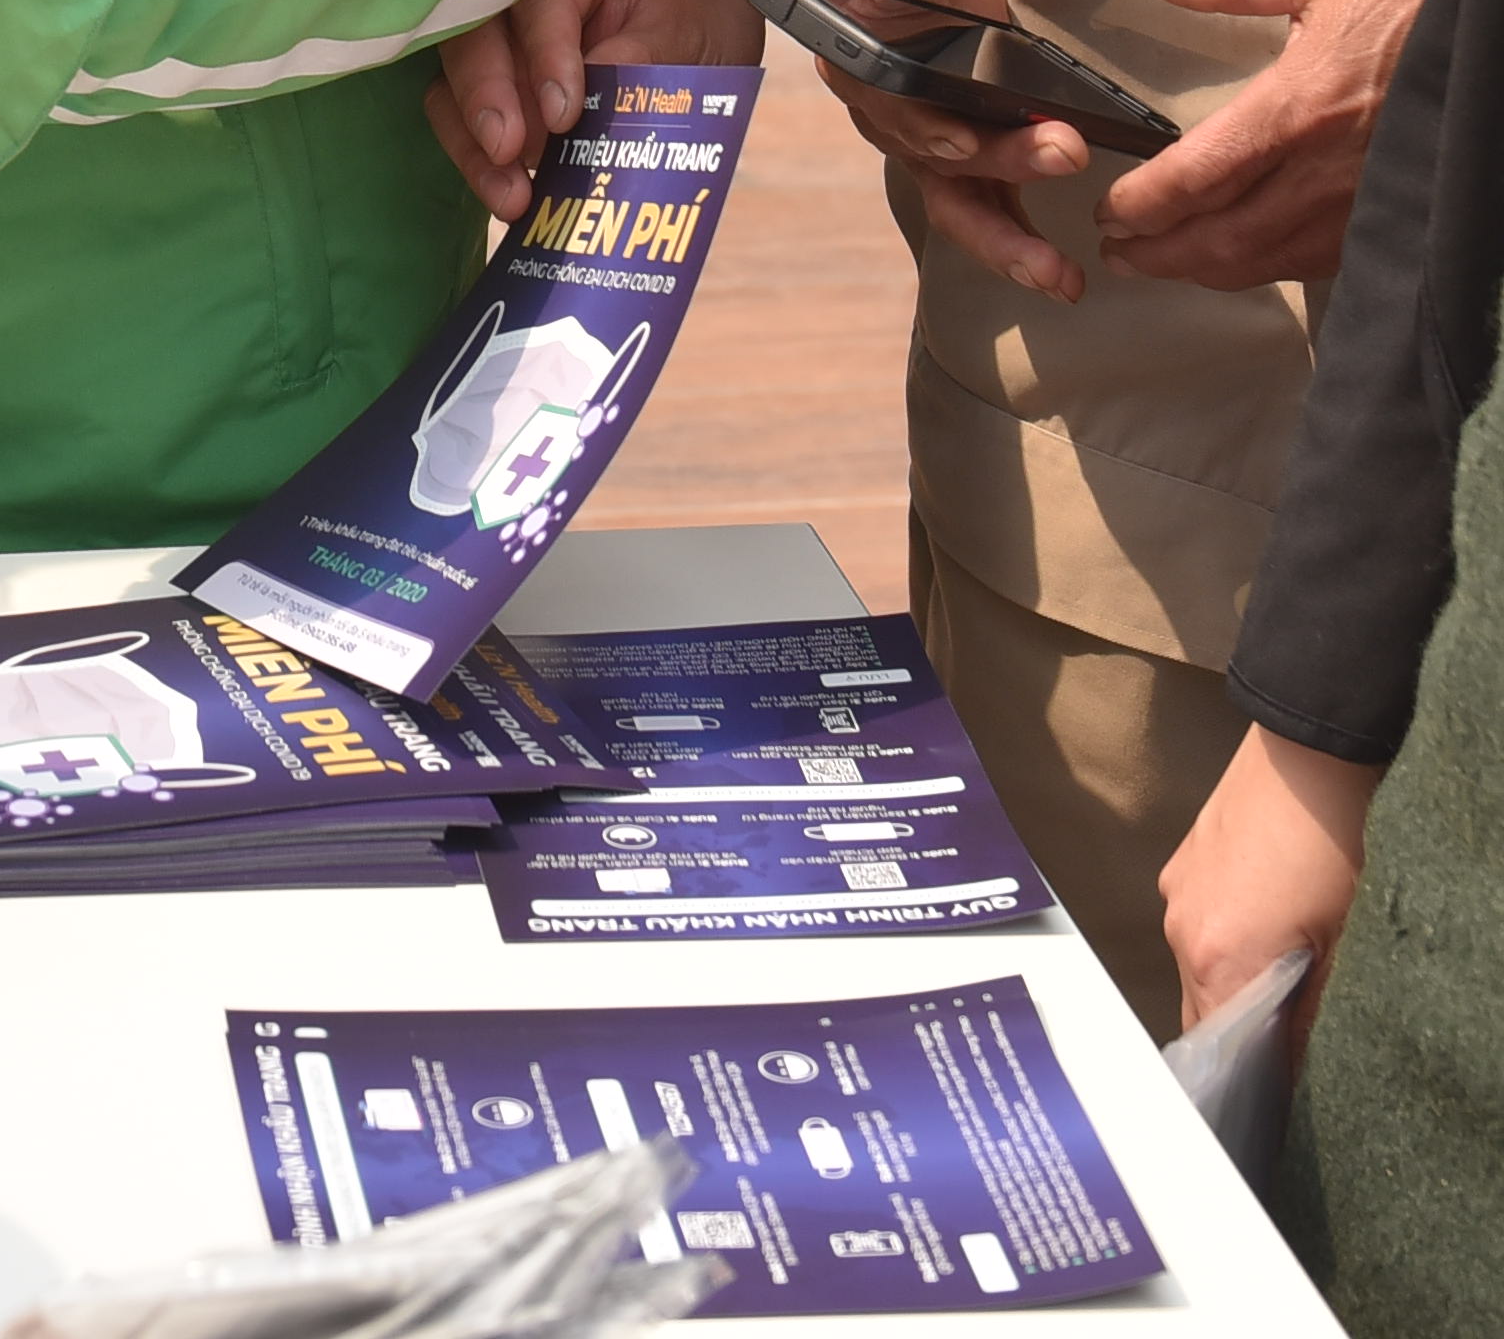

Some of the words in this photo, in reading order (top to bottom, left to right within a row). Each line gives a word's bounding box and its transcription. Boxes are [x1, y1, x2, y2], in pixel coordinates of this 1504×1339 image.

[649, 87, 692, 114] Health
[570, 134, 616, 173] TRIỆU
[615, 131, 664, 170] KHẨU
[665, 143, 723, 172] TRANG
[522, 173, 631, 257] MIỄN
[622, 189, 710, 263] PHÍ
[386, 577, 428, 603] 2020
[280, 708, 407, 776] PHÍ
[382, 710, 451, 772] TRANG
[490, 707, 556, 767] TRANG
[742, 909, 839, 930] NHẬN
[844, 902, 945, 925] TRÌNH
[951, 895, 1018, 918] QUY
[527, 916, 634, 934] TRANG
[644, 915, 736, 934] KHẨU
